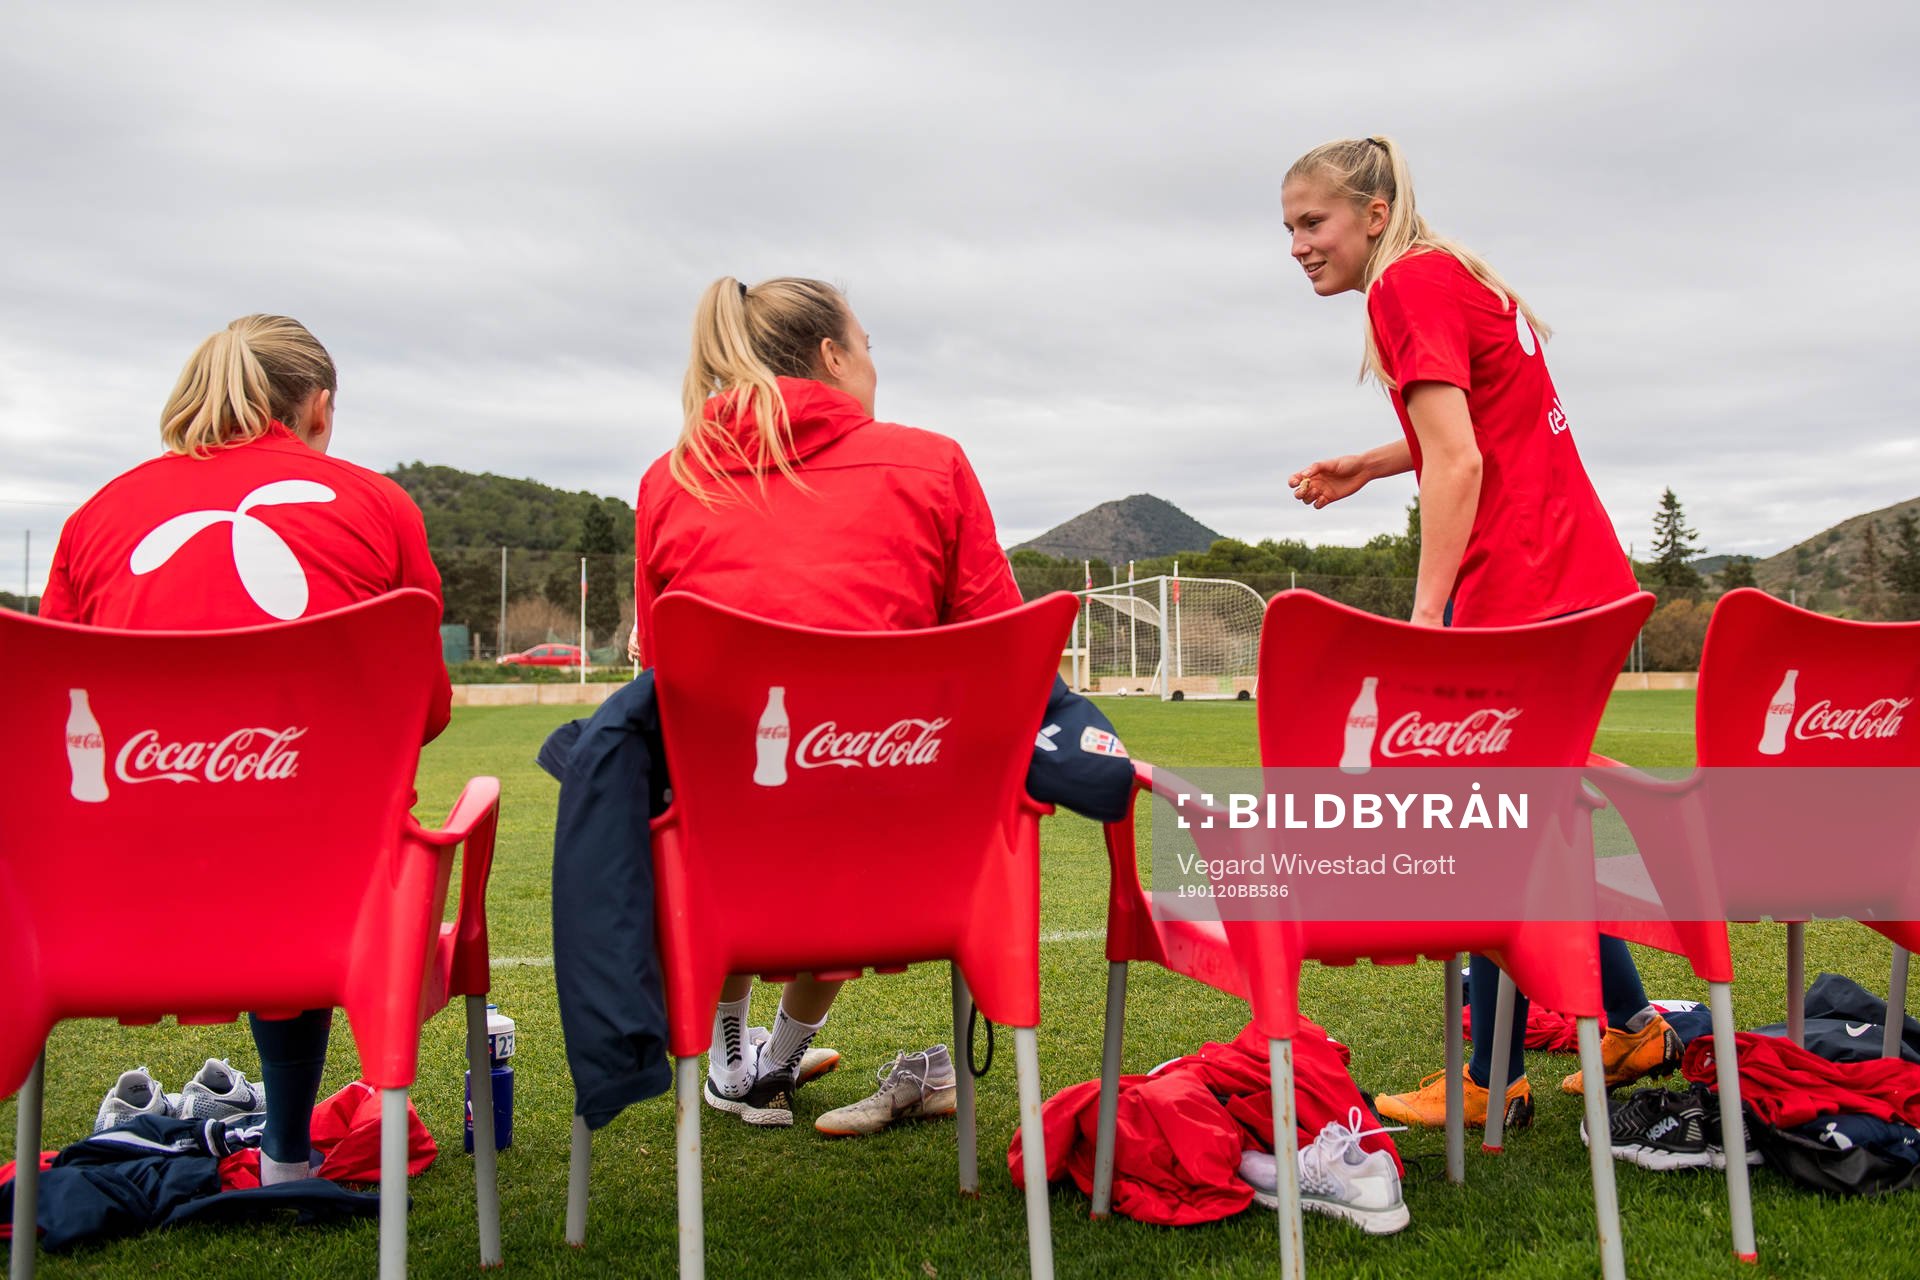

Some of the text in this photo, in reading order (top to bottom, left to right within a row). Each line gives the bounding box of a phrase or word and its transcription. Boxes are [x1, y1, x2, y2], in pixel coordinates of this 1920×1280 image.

[795, 717, 952, 769] Coca-Cola
[1380, 707, 1524, 758] Coca-Cola
[1794, 697, 1914, 740] Coca-Cola
[115, 726, 309, 784] Coca-Cola
[1646, 1116, 1679, 1141] HOKA
